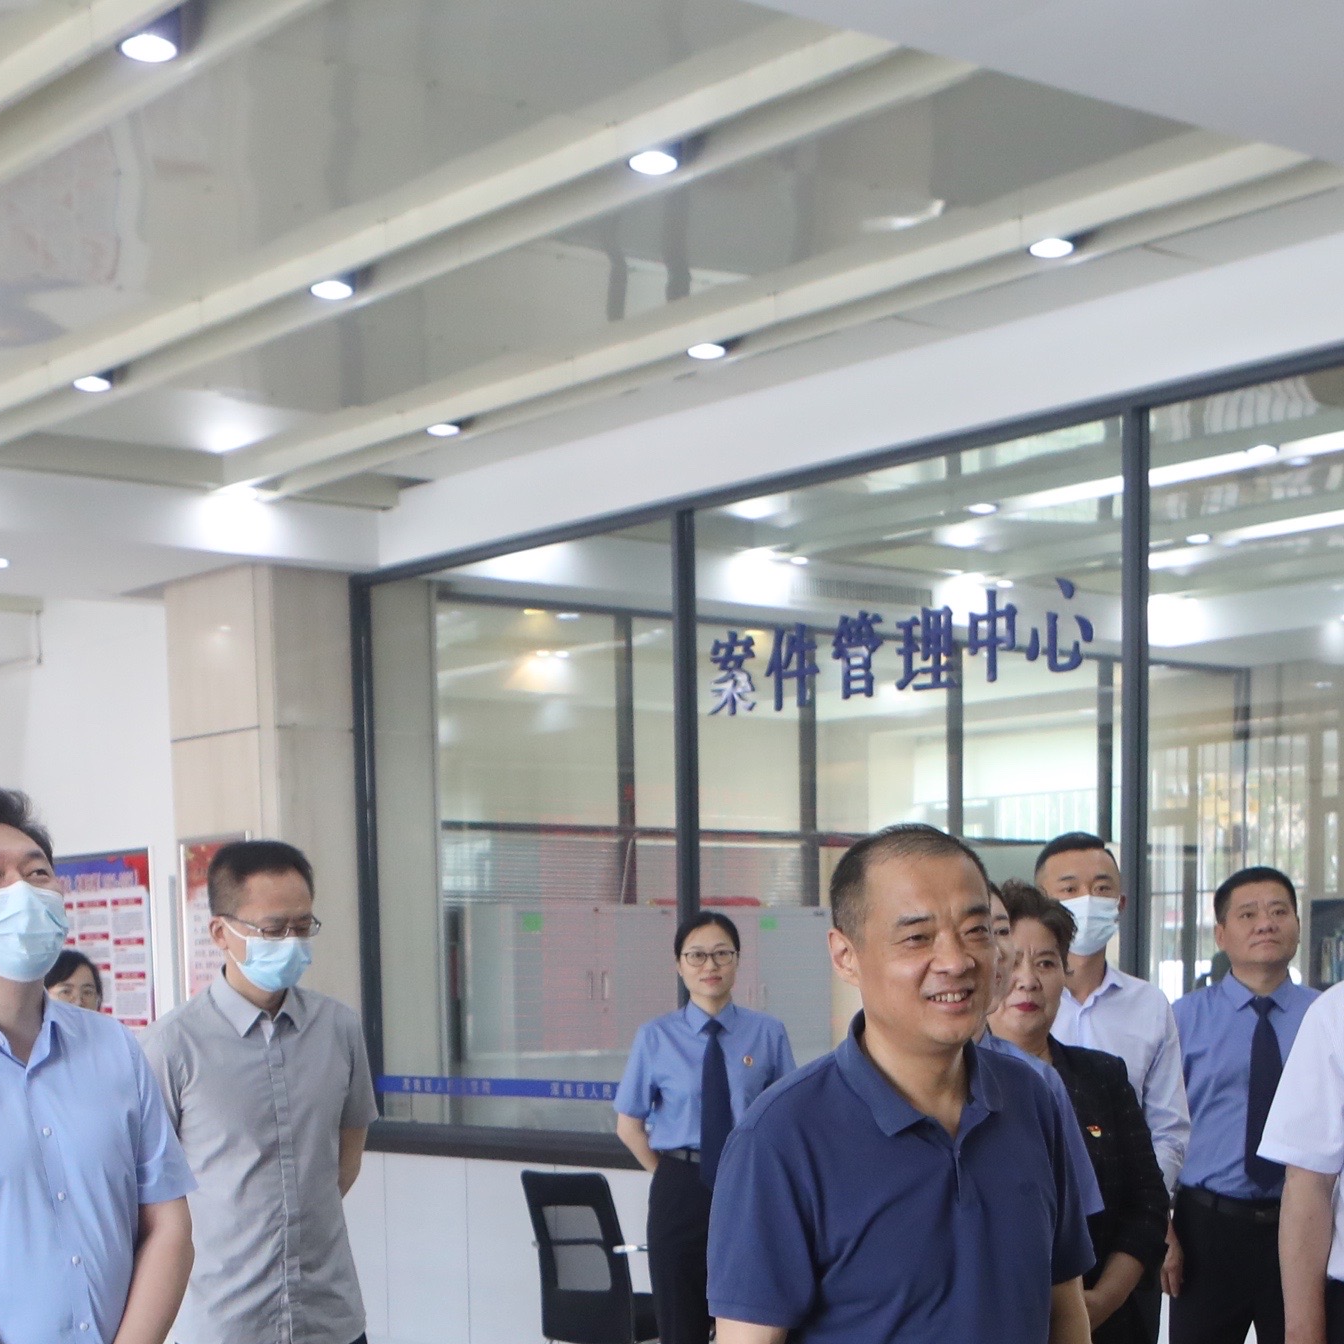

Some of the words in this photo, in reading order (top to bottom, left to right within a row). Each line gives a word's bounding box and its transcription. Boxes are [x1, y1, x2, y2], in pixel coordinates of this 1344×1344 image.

[708, 577, 1093, 716] 案件管理中心
